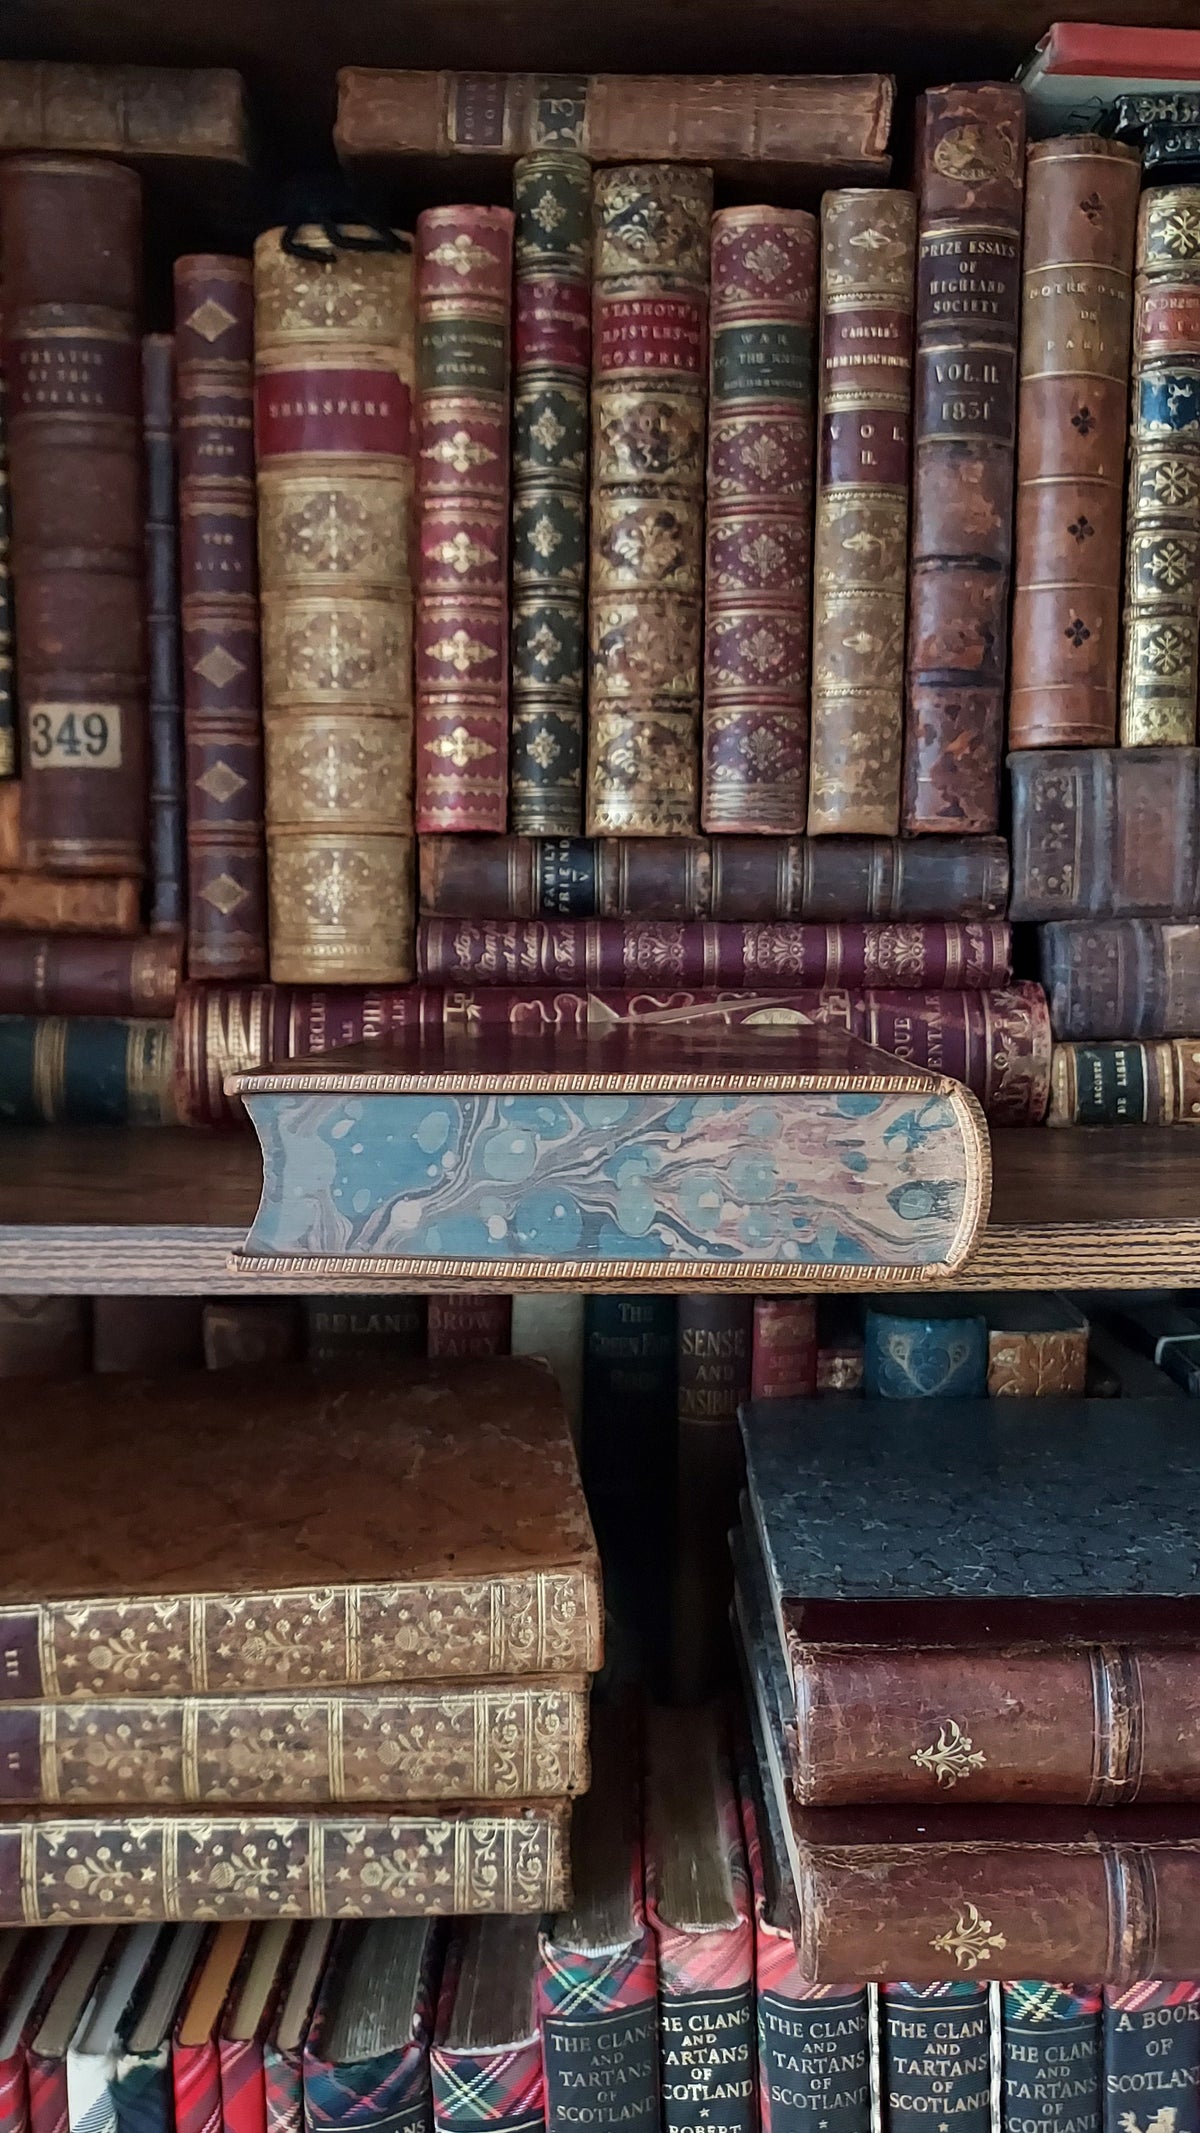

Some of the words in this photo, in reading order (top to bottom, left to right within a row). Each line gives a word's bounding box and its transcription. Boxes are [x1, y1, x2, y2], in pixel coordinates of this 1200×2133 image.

[921, 241, 966, 259] PRIZE
[969, 240, 1015, 258] ESSAYS
[959, 261, 977, 274] OF
[929, 278, 1005, 297] HIGHLAND
[932, 299, 998, 315] SOCIETY
[944, 401, 986, 421] 1851
[32, 711, 108, 756] 349
[544, 842, 556, 907] FAMILY
[559, 839, 571, 913] FRIEND
[428, 1305, 494, 1334] BROW
[681, 1327, 745, 1358] SENSE
[695, 1364, 735, 1382] AND
[662, 2016, 683, 2033] HE
[687, 2008, 750, 2034] CLANS
[765, 2012, 804, 2039] THE
[809, 2014, 867, 2040] CLANS
[887, 2018, 928, 2039] THE
[1115, 2012, 1137, 2032] A
[1141, 2002, 1200, 2030] BOOK
[551, 2032, 592, 2053] THE
[597, 2022, 658, 2051] CLANS
[681, 2033, 718, 2048] AND
[801, 2041, 838, 2054] AND
[923, 2042, 961, 2056] AND
[1145, 2038, 1174, 2058] OF
[590, 2051, 625, 2068] AND
[662, 2044, 750, 2067] ARTANS
[772, 2049, 866, 2075] TARTANS
[1044, 2040, 1097, 2063] CLAN
[558, 2059, 652, 2088] TARTANS
[690, 2068, 714, 2081] OF
[893, 2052, 988, 2078] TARTANS
[1034, 2065, 1071, 2080] AND
[661, 2078, 754, 2102] COTLAND
[810, 2077, 832, 2091] OF
[931, 2080, 955, 2095] OF
[1005, 2076, 1098, 2100] TARTANS
[597, 2090, 618, 2104] OF
[770, 2086, 868, 2111] SCOTLAND
[889, 2089, 990, 2115] SCOTLAND
[555, 2095, 657, 2124] SCOTLAND
[1041, 2102, 1065, 2116] OF
